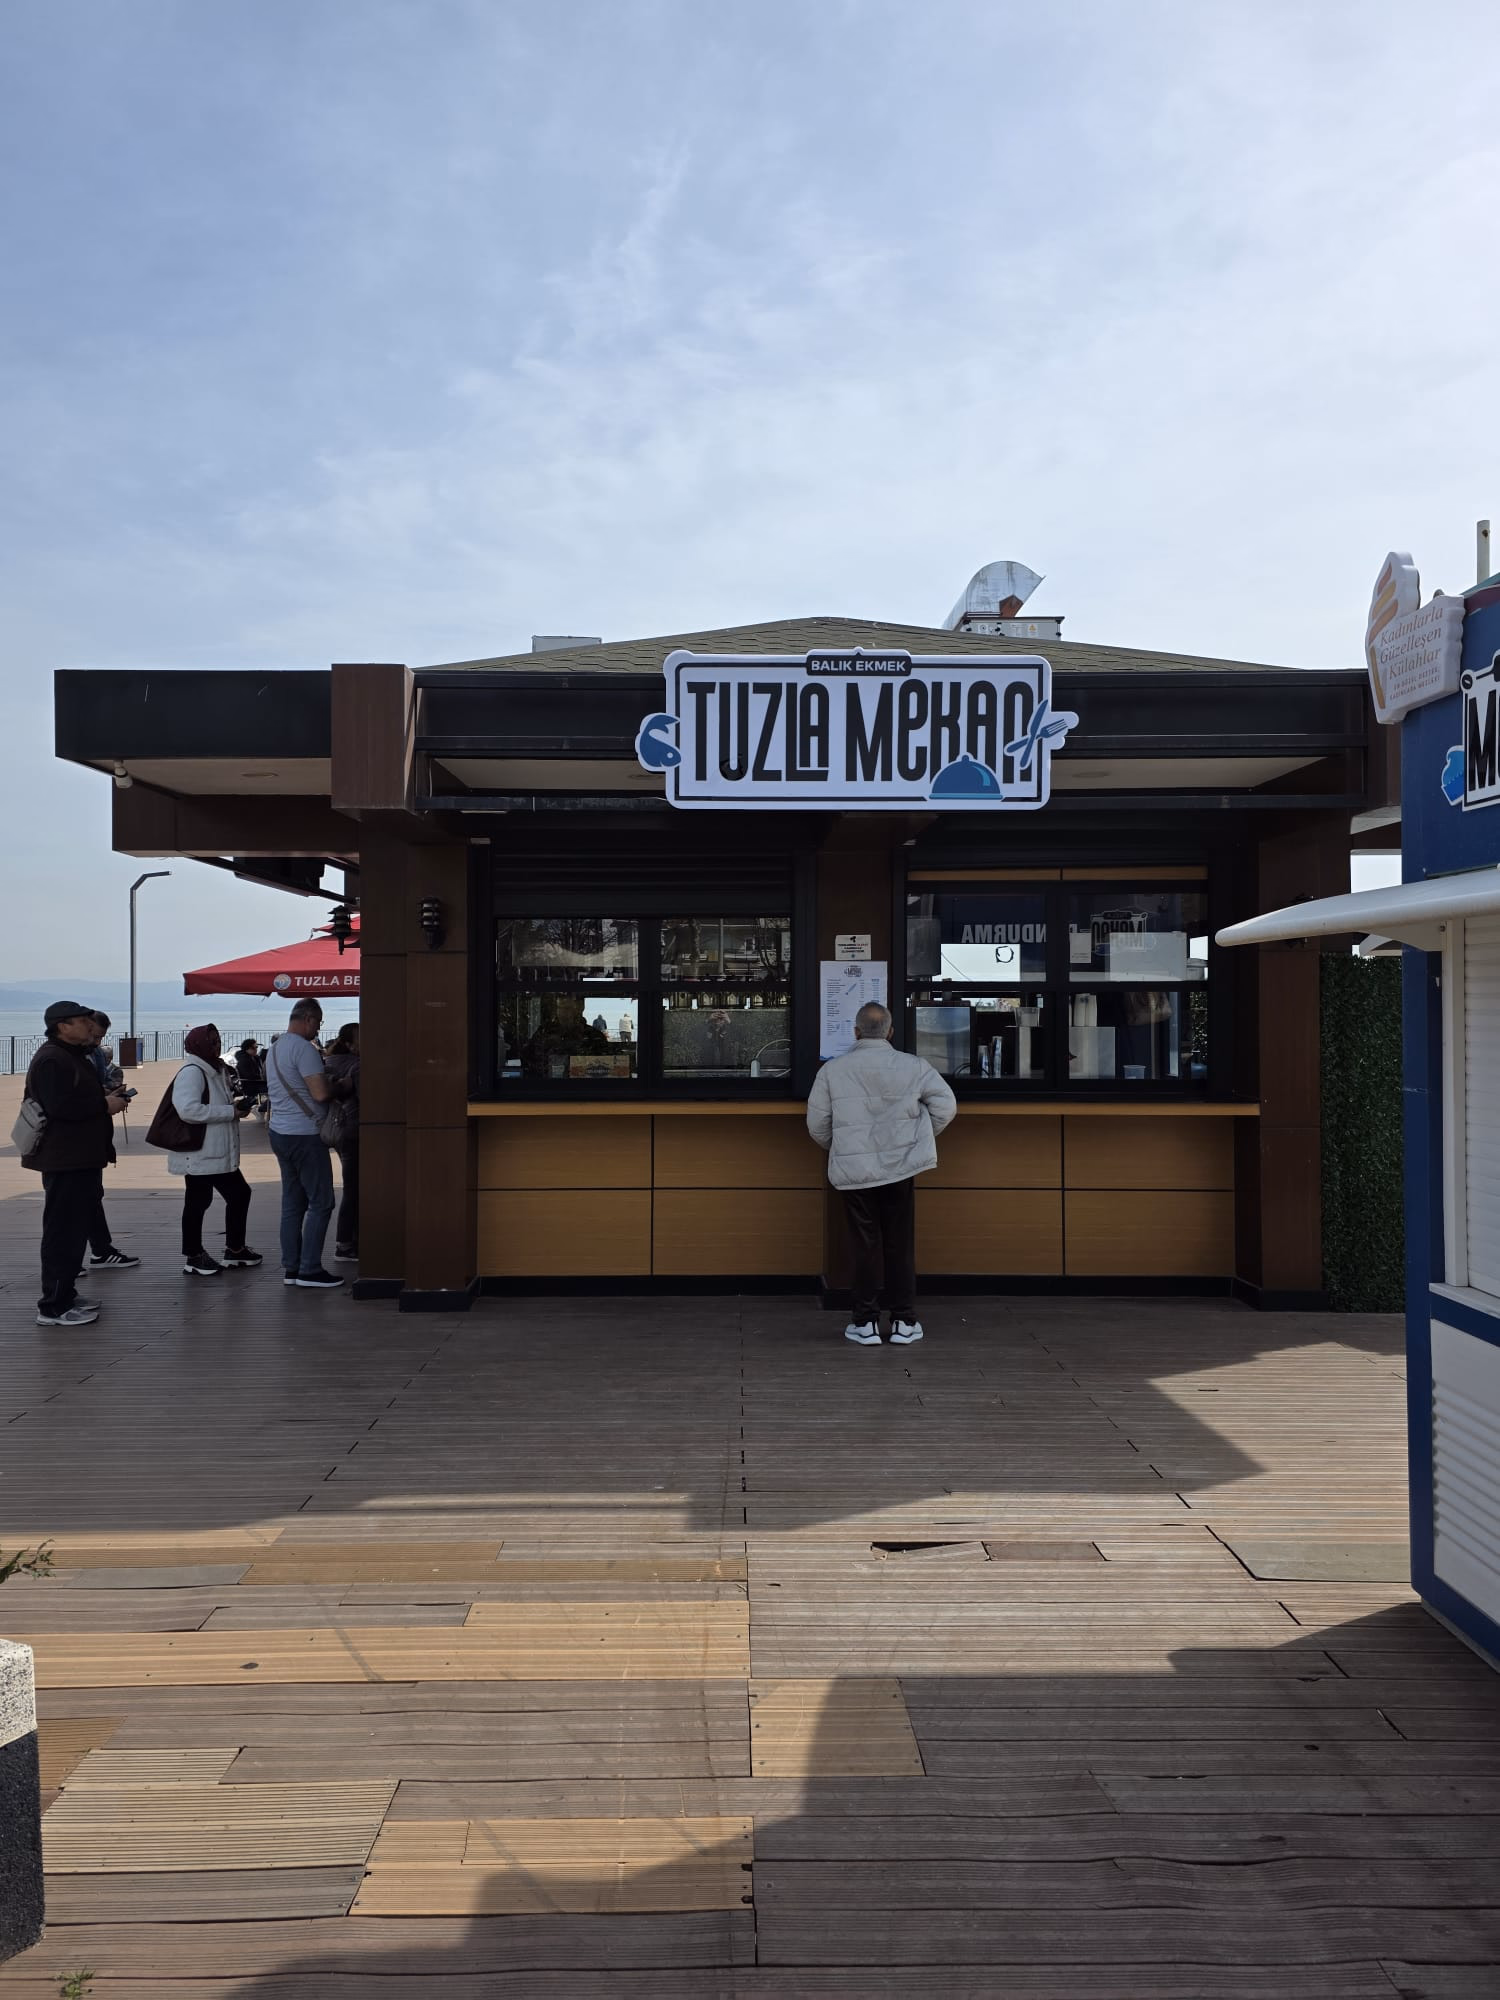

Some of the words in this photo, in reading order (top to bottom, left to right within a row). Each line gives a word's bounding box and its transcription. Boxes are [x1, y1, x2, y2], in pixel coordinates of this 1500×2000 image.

[1380, 606, 1444, 647] Kadınlarla
[1380, 627, 1442, 665] Güzelleşen
[1389, 647, 1442, 680] Külahlar
[811, 660, 852, 671] BALIK
[855, 660, 906, 672] EKMEK
[687, 680, 830, 782] TUZLA
[845, 678, 1035, 784] MEKAN
[1469, 689, 1500, 791] M
[295, 976, 340, 987] TUZLA
